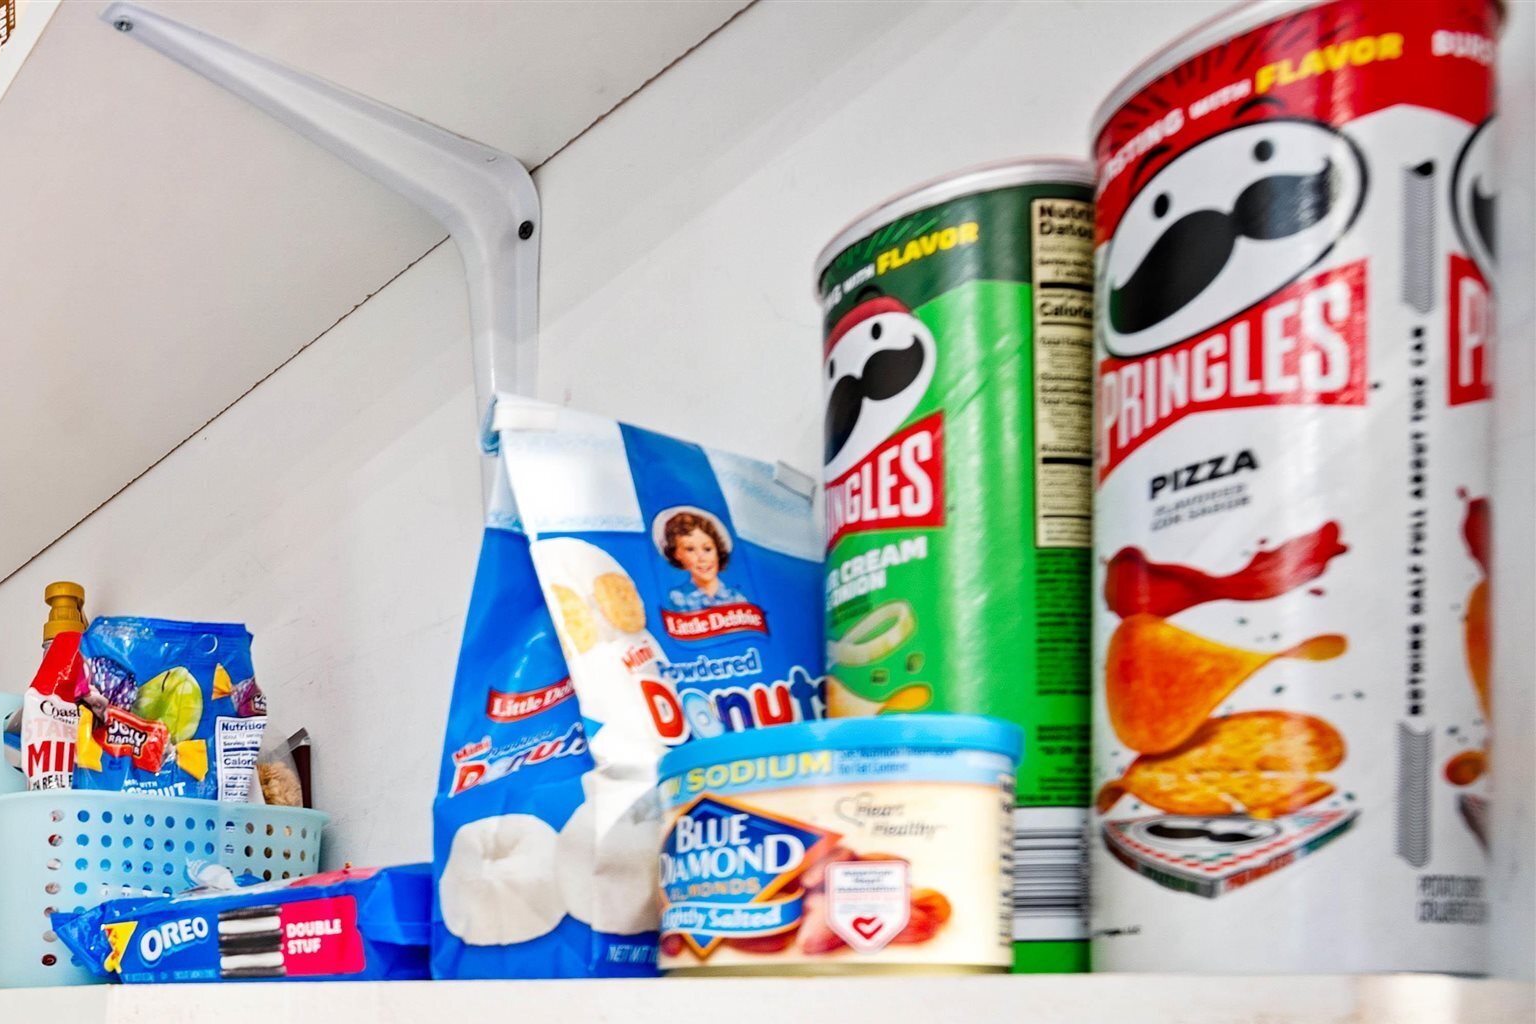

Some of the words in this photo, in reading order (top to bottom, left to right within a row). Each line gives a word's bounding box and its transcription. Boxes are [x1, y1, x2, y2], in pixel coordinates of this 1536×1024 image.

[1254, 33, 1404, 95] FLAVOR
[875, 222, 980, 276] FLAVOR
[1100, 280, 1353, 470] PRINGLES
[1149, 449, 1260, 500] PIZZA
[840, 535, 929, 586] CREAM
[490, 693, 544, 718] Little
[686, 750, 833, 792] SODIUM
[676, 813, 750, 855] BLUE
[659, 833, 806, 888] DIAMOND
[139, 916, 209, 962] OREO
[285, 918, 343, 939] DOUBLE
[287, 938, 322, 956] STUF
